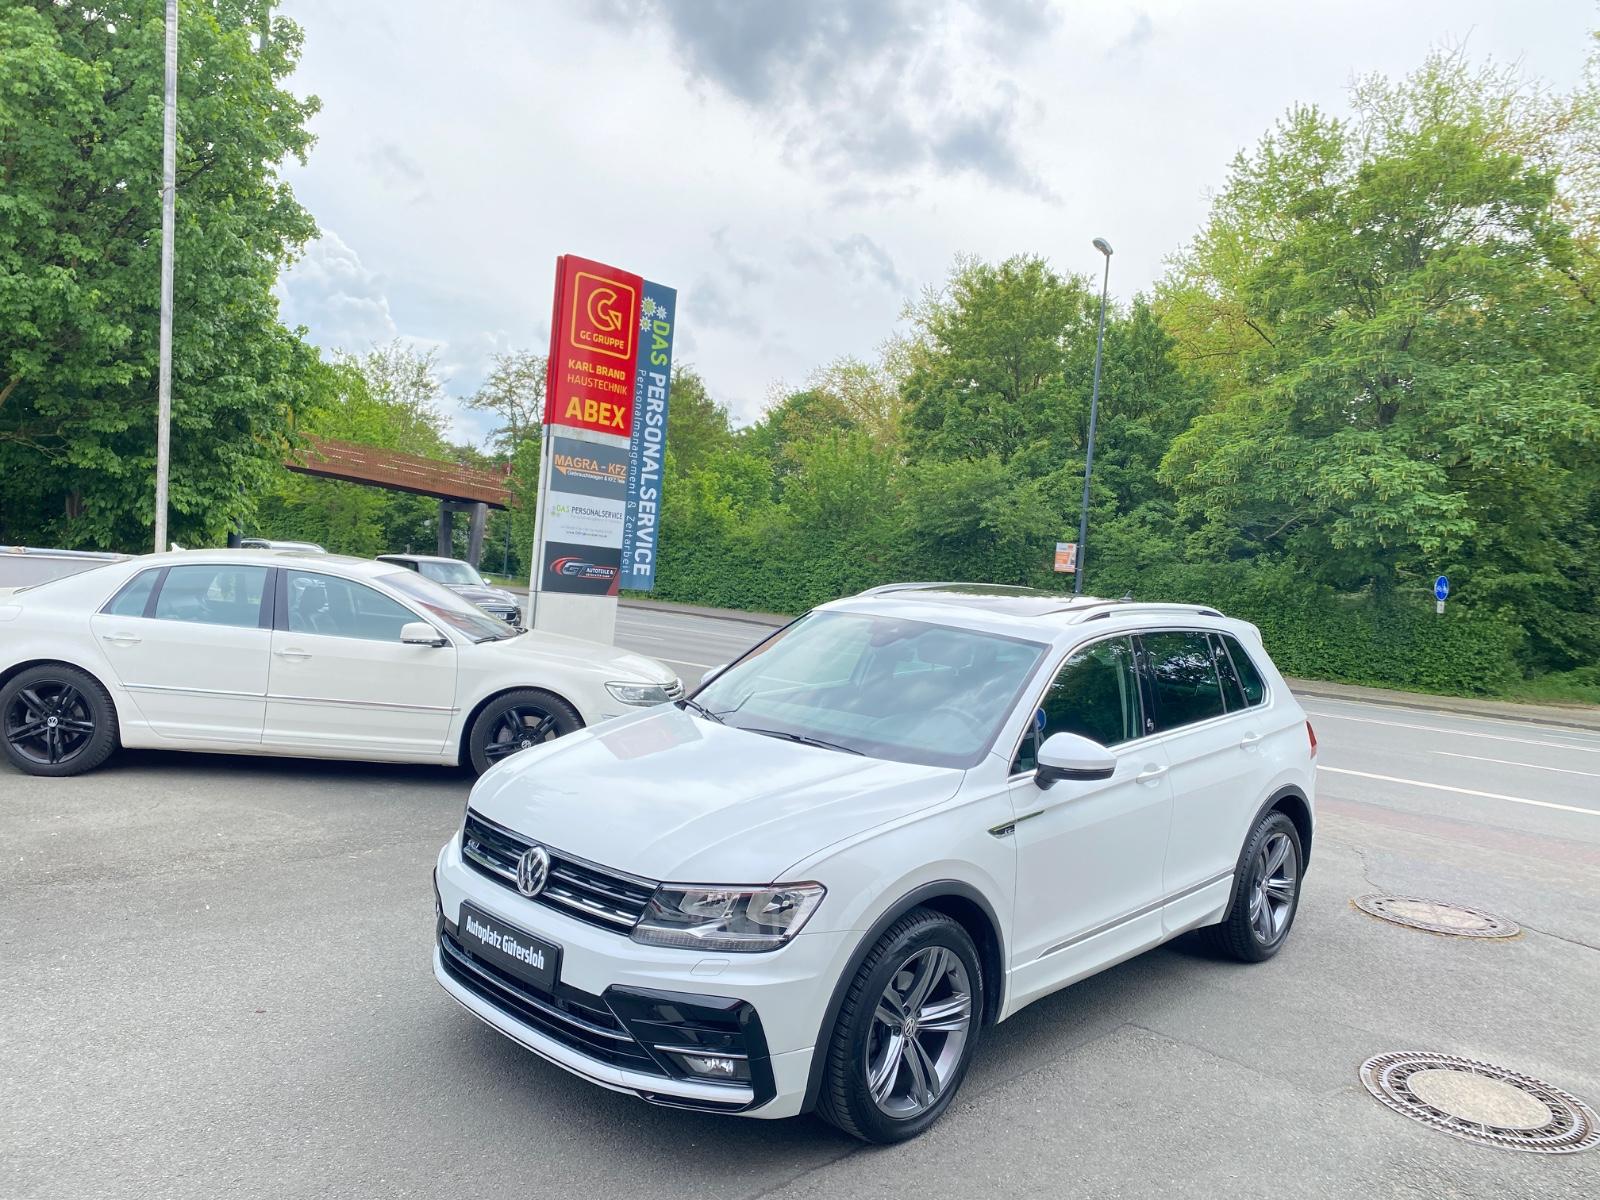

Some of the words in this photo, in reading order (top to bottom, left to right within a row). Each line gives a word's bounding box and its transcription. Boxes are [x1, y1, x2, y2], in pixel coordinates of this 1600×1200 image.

[580, 330, 591, 341] GC
[592, 332, 624, 349] GRUPPE
[651, 320, 670, 366] DAS
[568, 359, 594, 374] KARL
[595, 365, 626, 381] BRAND
[567, 374, 628, 395] HAUSTECHNIK
[565, 397, 626, 429] ABEX
[628, 369, 646, 494] Personalmanagement
[554, 454, 598, 471] MAGRA
[608, 463, 626, 476] KFZ
[633, 372, 667, 576] PERSONALSERVICE
[571, 506, 623, 520] PERSONALSERVICE
[621, 516, 636, 574] Zeitarbeit
[585, 567, 610, 575] AUTOTEILE
[466, 915, 502, 949] Autoplatz
[502, 935, 544, 970] Gütersloh
